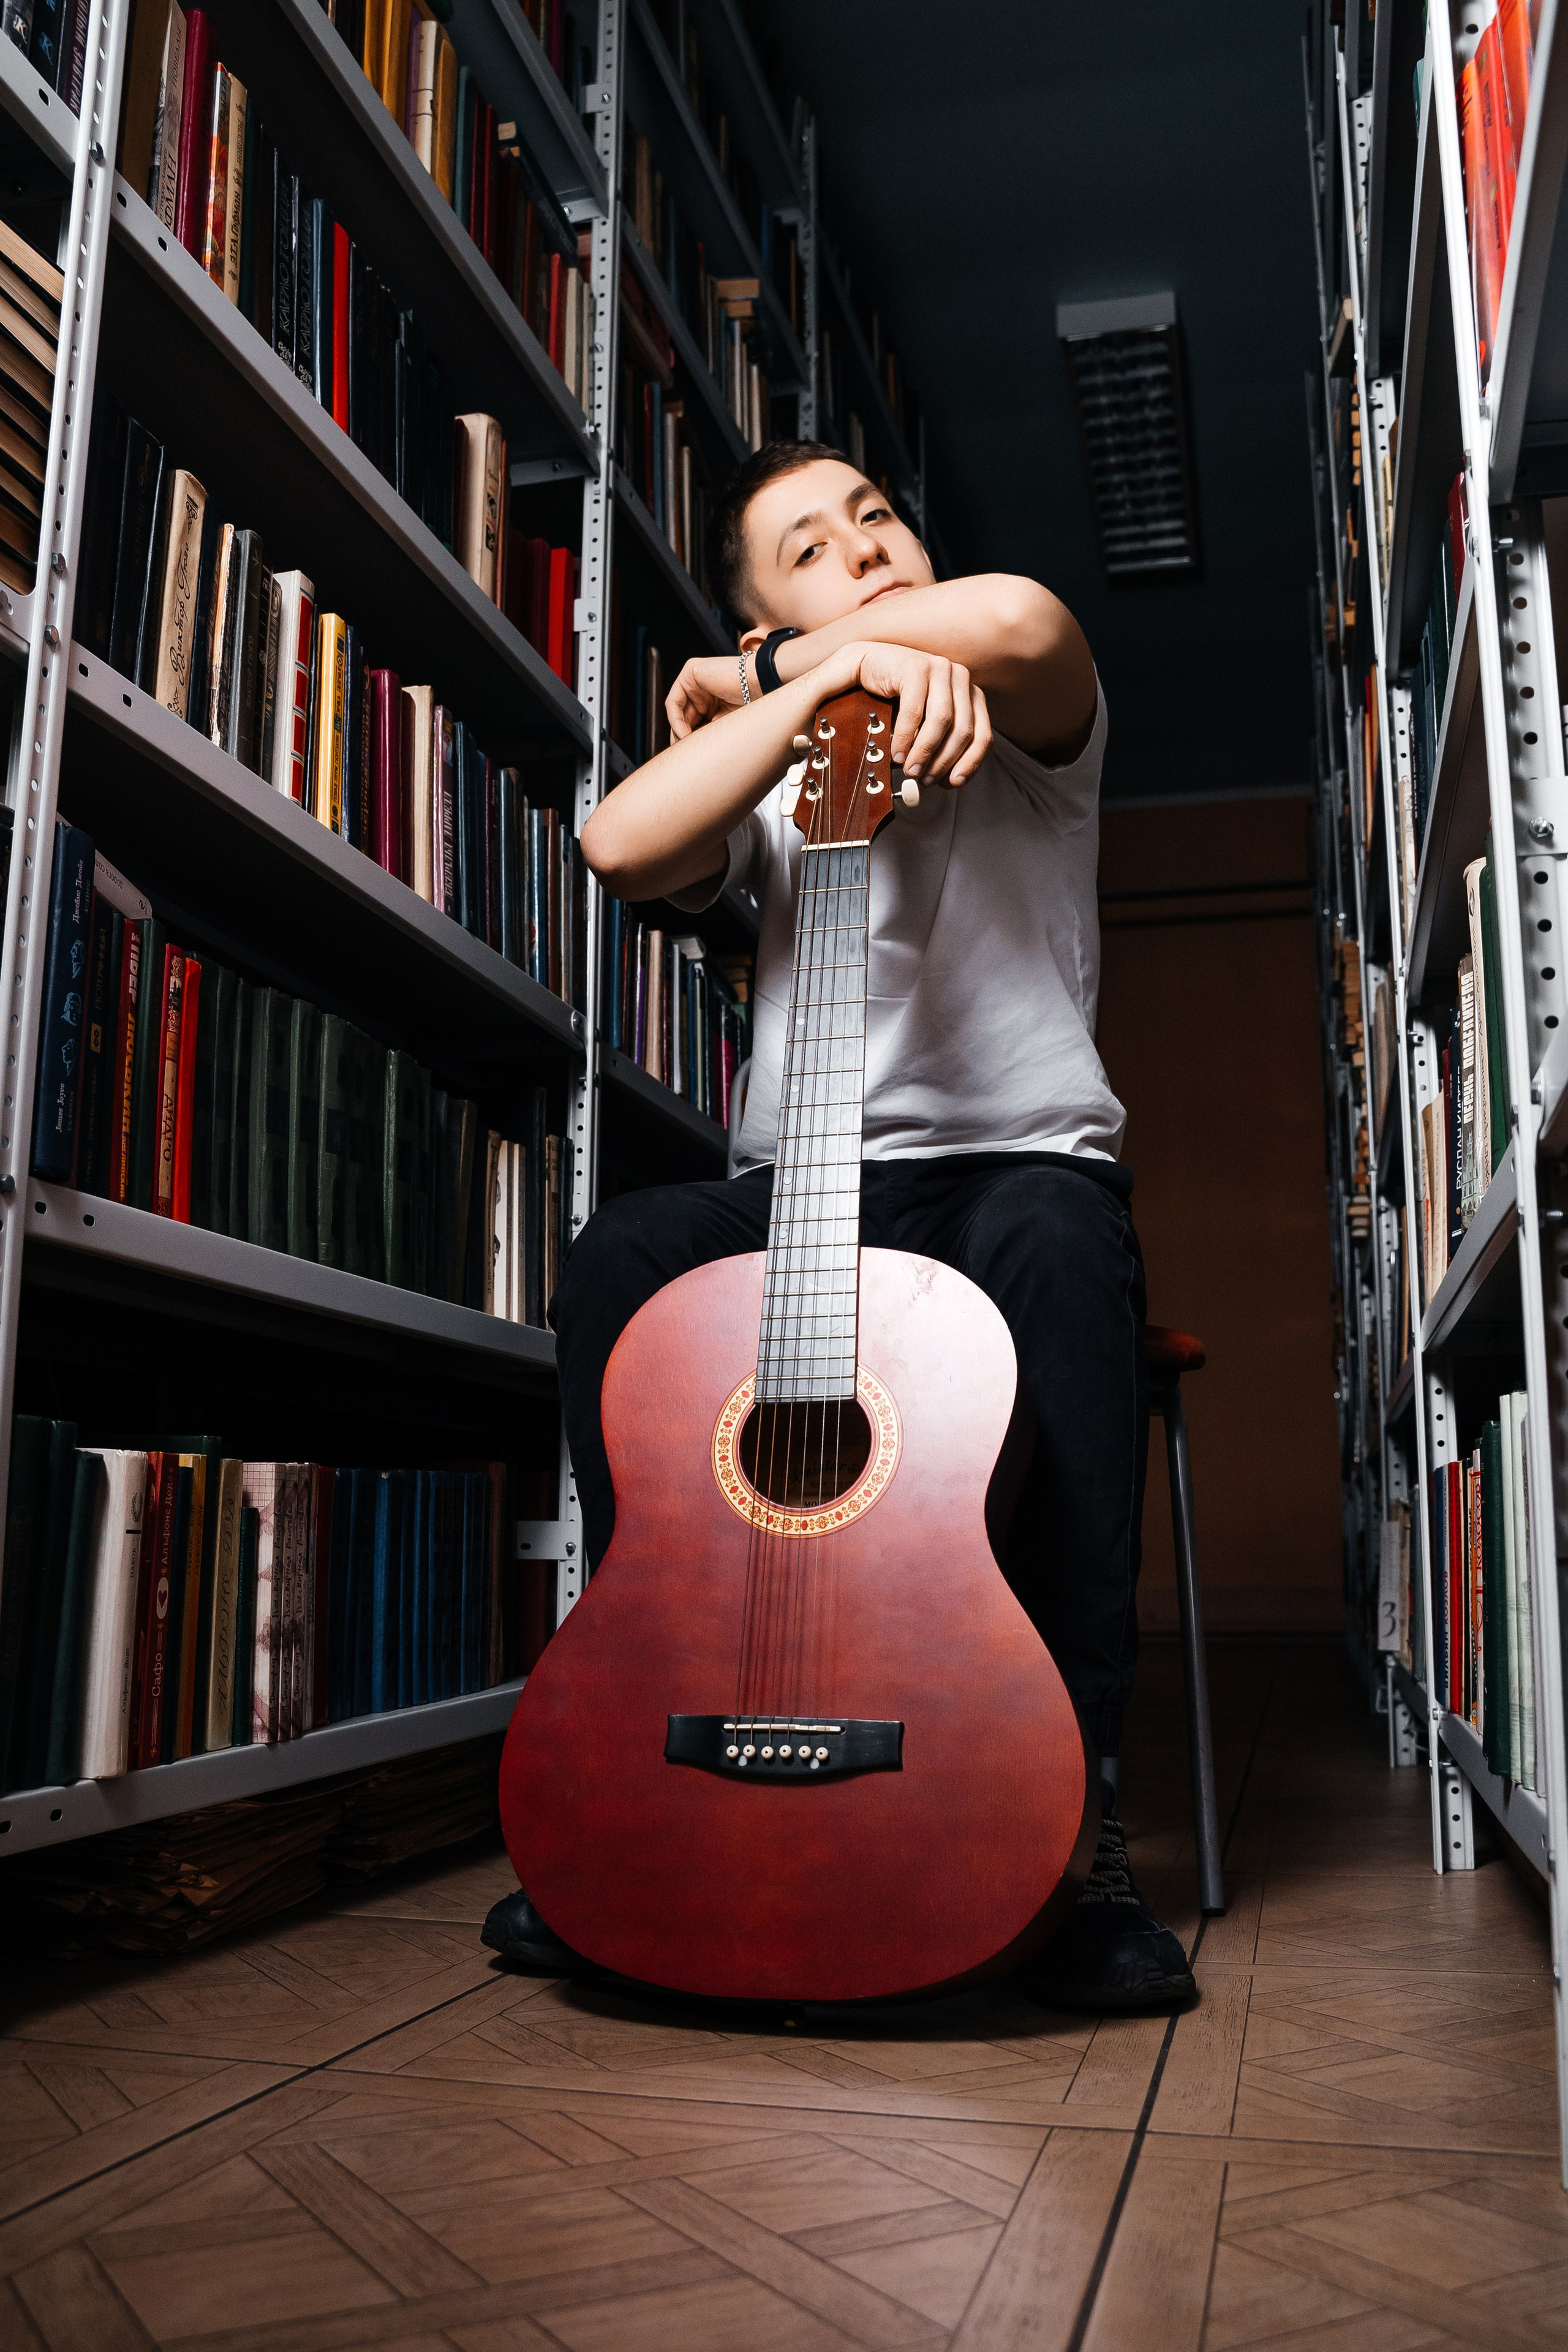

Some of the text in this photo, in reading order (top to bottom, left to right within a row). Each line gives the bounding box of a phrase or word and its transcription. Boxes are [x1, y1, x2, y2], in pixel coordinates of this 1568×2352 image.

[70, 47, 84, 115] ЗАВТРАК
[172, 25, 181, 88] НОВЕЛЛЫ
[279, 263, 290, 336] КАРЛО
[300, 287, 311, 358] КАРЛО
[169, 541, 190, 686] Виктор Гюго
[443, 790, 453, 839] ДАРРЕЛЛ
[72, 889, 81, 924] Джеймс
[94, 927, 107, 1010] ПОТЕРЯННЫЙ
[129, 944, 140, 1004] ПЬЕР
[1461, 970, 1474, 1125] ПЕСНЬ ПОБЕДИТЕЛЯ
[57, 1083, 66, 1106] Joyce
[162, 1094, 174, 1163] ДИДРО
[160, 1475, 174, 1566] Альфонс Доде
[217, 1564, 233, 1716] АЛЬФОНС
[1382, 1601, 1396, 1637] 3
[151, 1652, 164, 1697] Сафо
